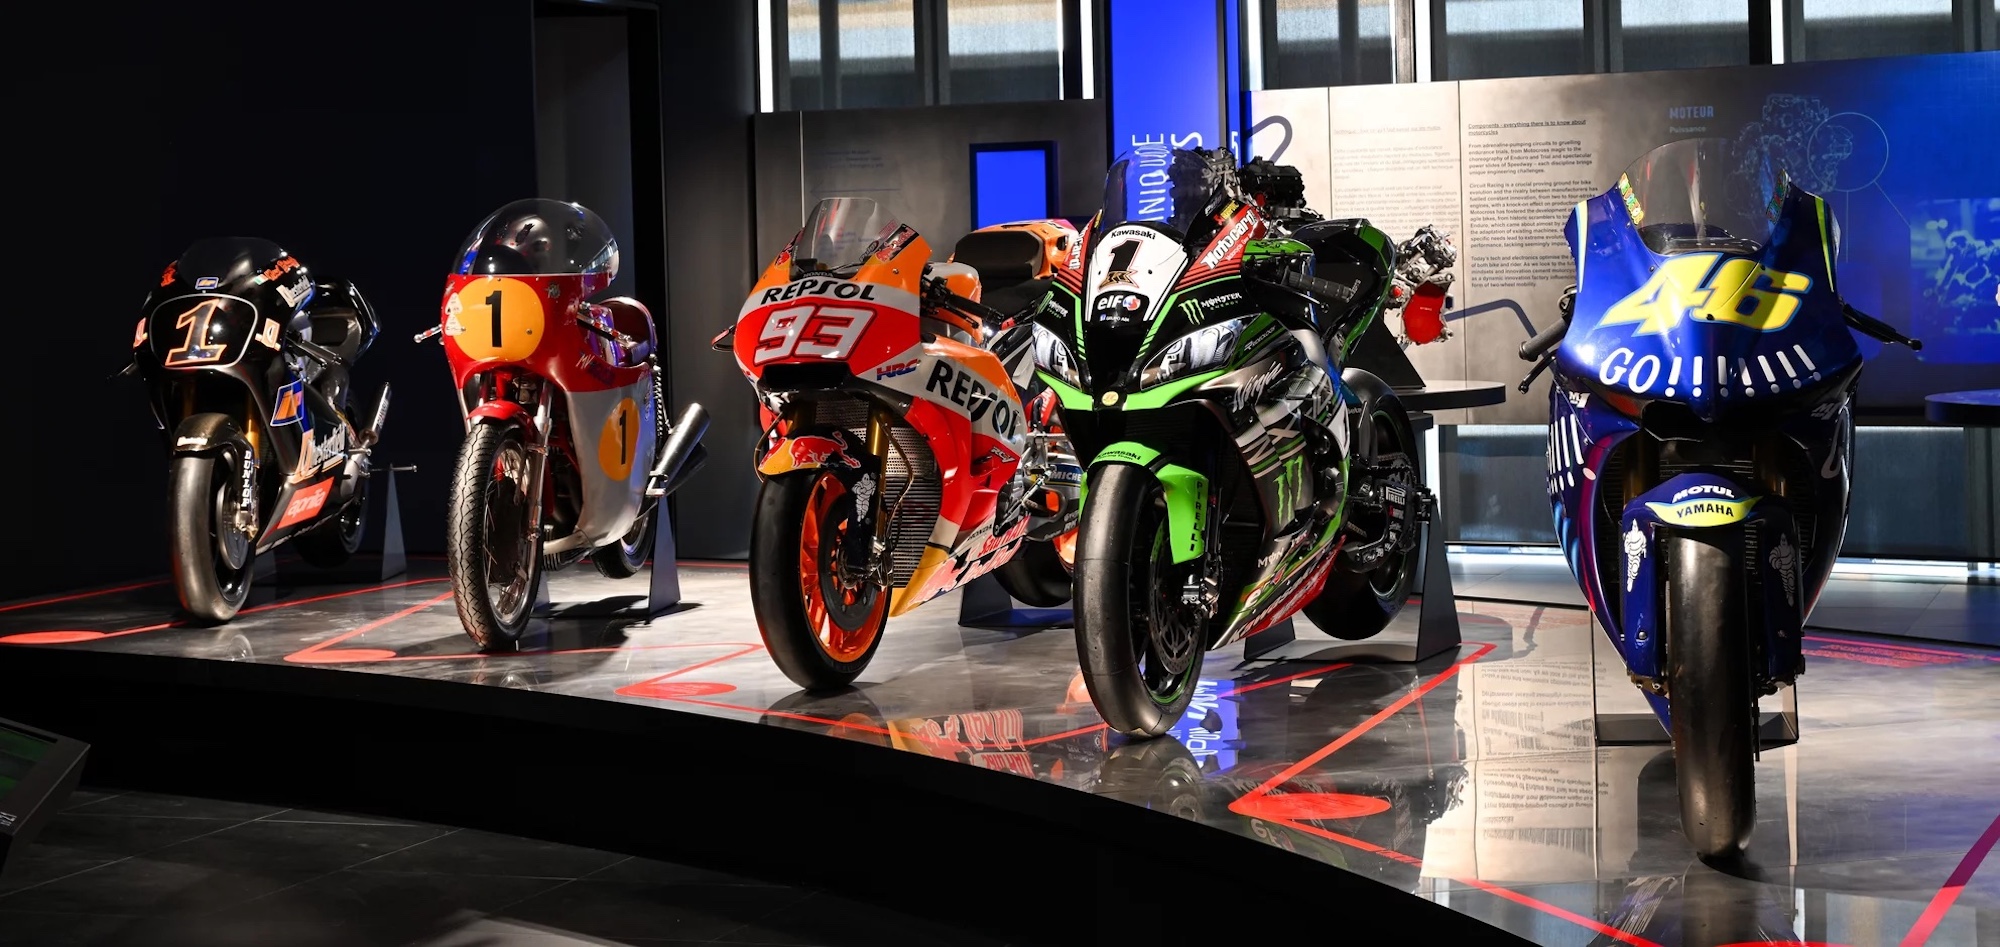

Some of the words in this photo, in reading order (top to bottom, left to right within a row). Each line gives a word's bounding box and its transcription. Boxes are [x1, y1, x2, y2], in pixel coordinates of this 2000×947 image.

[1669, 106, 1714, 119] MOTEUR
[1482, 141, 1532, 149] adrenaline-pumping
[1111, 228, 1156, 240] Kawasaki
[1200, 209, 1257, 270] Motocard!
[1108, 240, 1138, 272] 1
[761, 279, 875, 305] REPSOL
[1097, 295, 1123, 310] elf
[1200, 292, 1243, 308] MONSTER
[1598, 253, 1811, 335] 46
[165, 298, 227, 366] 1
[486, 290, 502, 347] 1
[754, 303, 876, 366] 93
[876, 358, 918, 381] HRC
[926, 360, 1020, 438] REPSOL
[1232, 361, 1284, 413] Ninja
[619, 410, 627, 465] 1
[1097, 450, 1142, 461] Kawasaki
[241, 450, 252, 508] DUNLOP
[1049, 472, 1081, 481] MICHE
[288, 489, 326, 518] aprilia
[1385, 486, 1406, 506] PIRELLI
[1672, 485, 1735, 504] MOTUL
[1190, 480, 1203, 552] PIRELLI
[1677, 504, 1735, 518] YAMAHA
